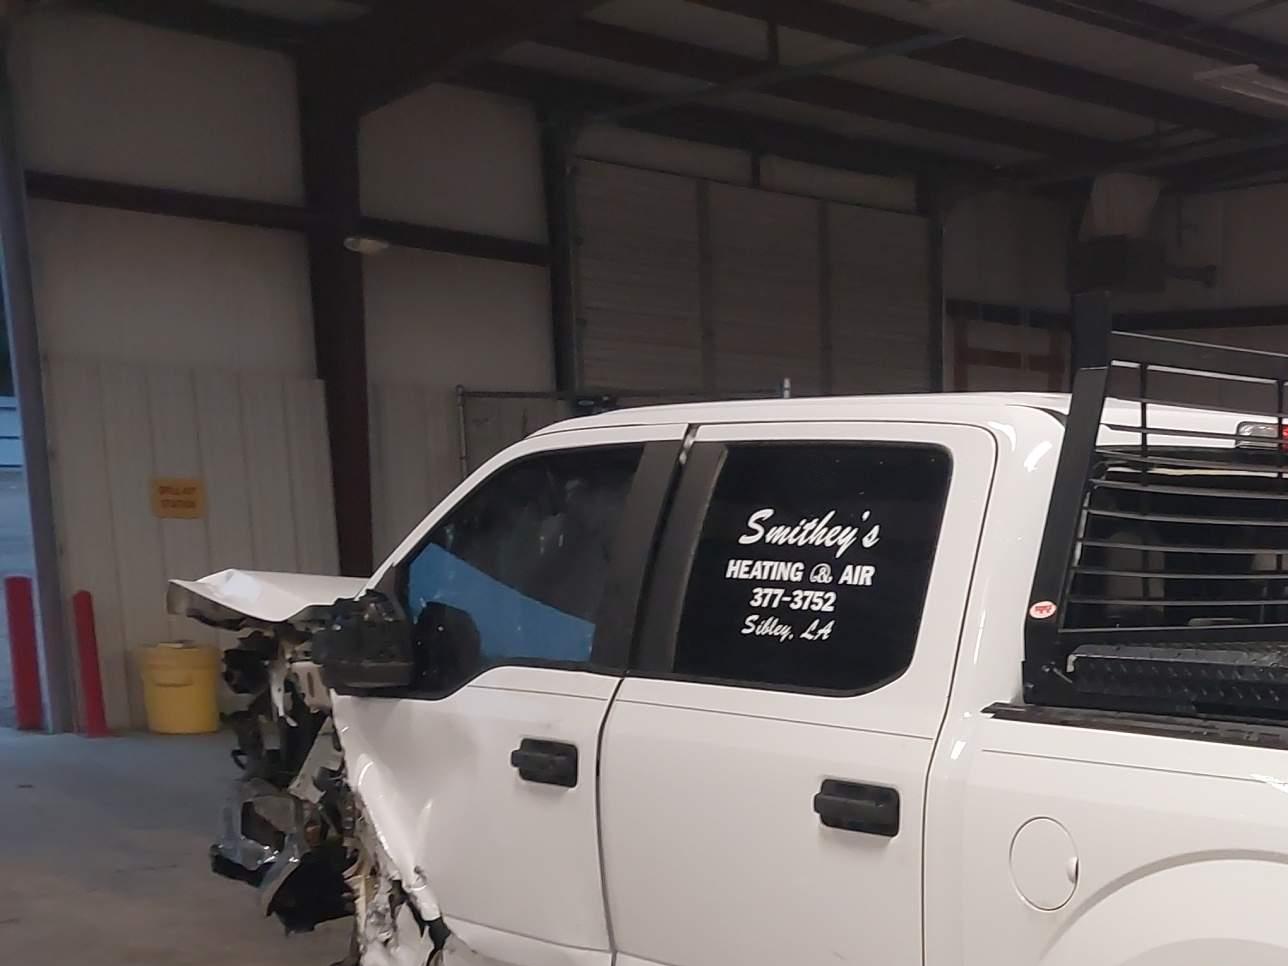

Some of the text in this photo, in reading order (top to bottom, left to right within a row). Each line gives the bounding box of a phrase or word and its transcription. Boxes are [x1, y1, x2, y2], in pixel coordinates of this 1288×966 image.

[738, 508, 880, 558] Smithey's
[725, 560, 805, 582] HEATING
[837, 564, 876, 586] AIR
[749, 588, 837, 611] 377-3752
[799, 619, 836, 641] LA
